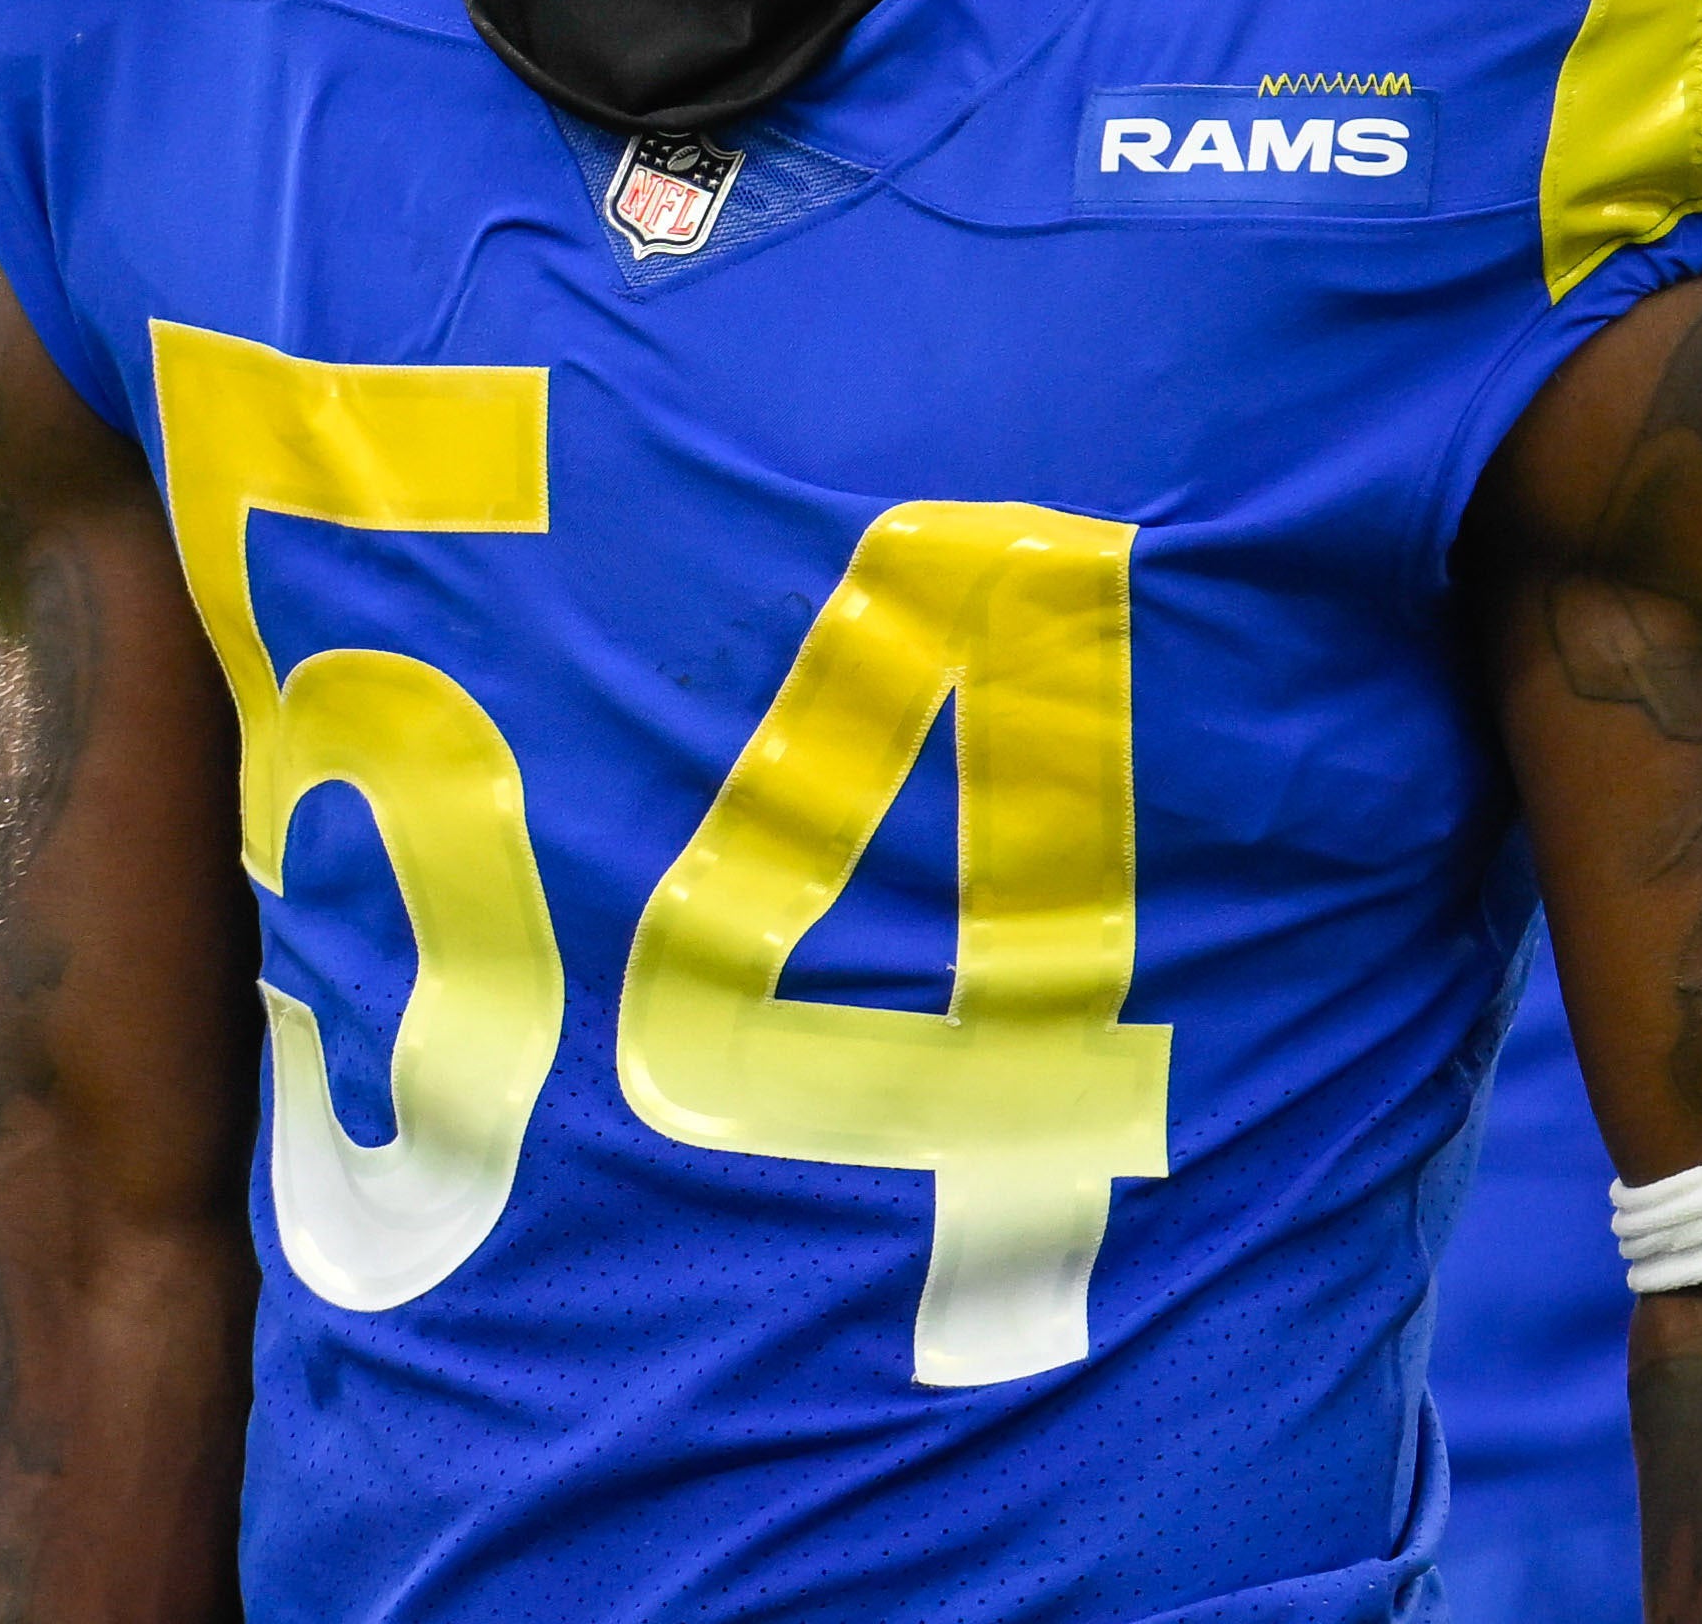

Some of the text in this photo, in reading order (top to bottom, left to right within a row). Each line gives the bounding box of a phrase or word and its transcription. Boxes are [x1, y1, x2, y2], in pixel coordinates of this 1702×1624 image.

[1100, 116, 1411, 177] RAMS
[619, 167, 700, 236] NFL
[148, 316, 1173, 1389] 54
